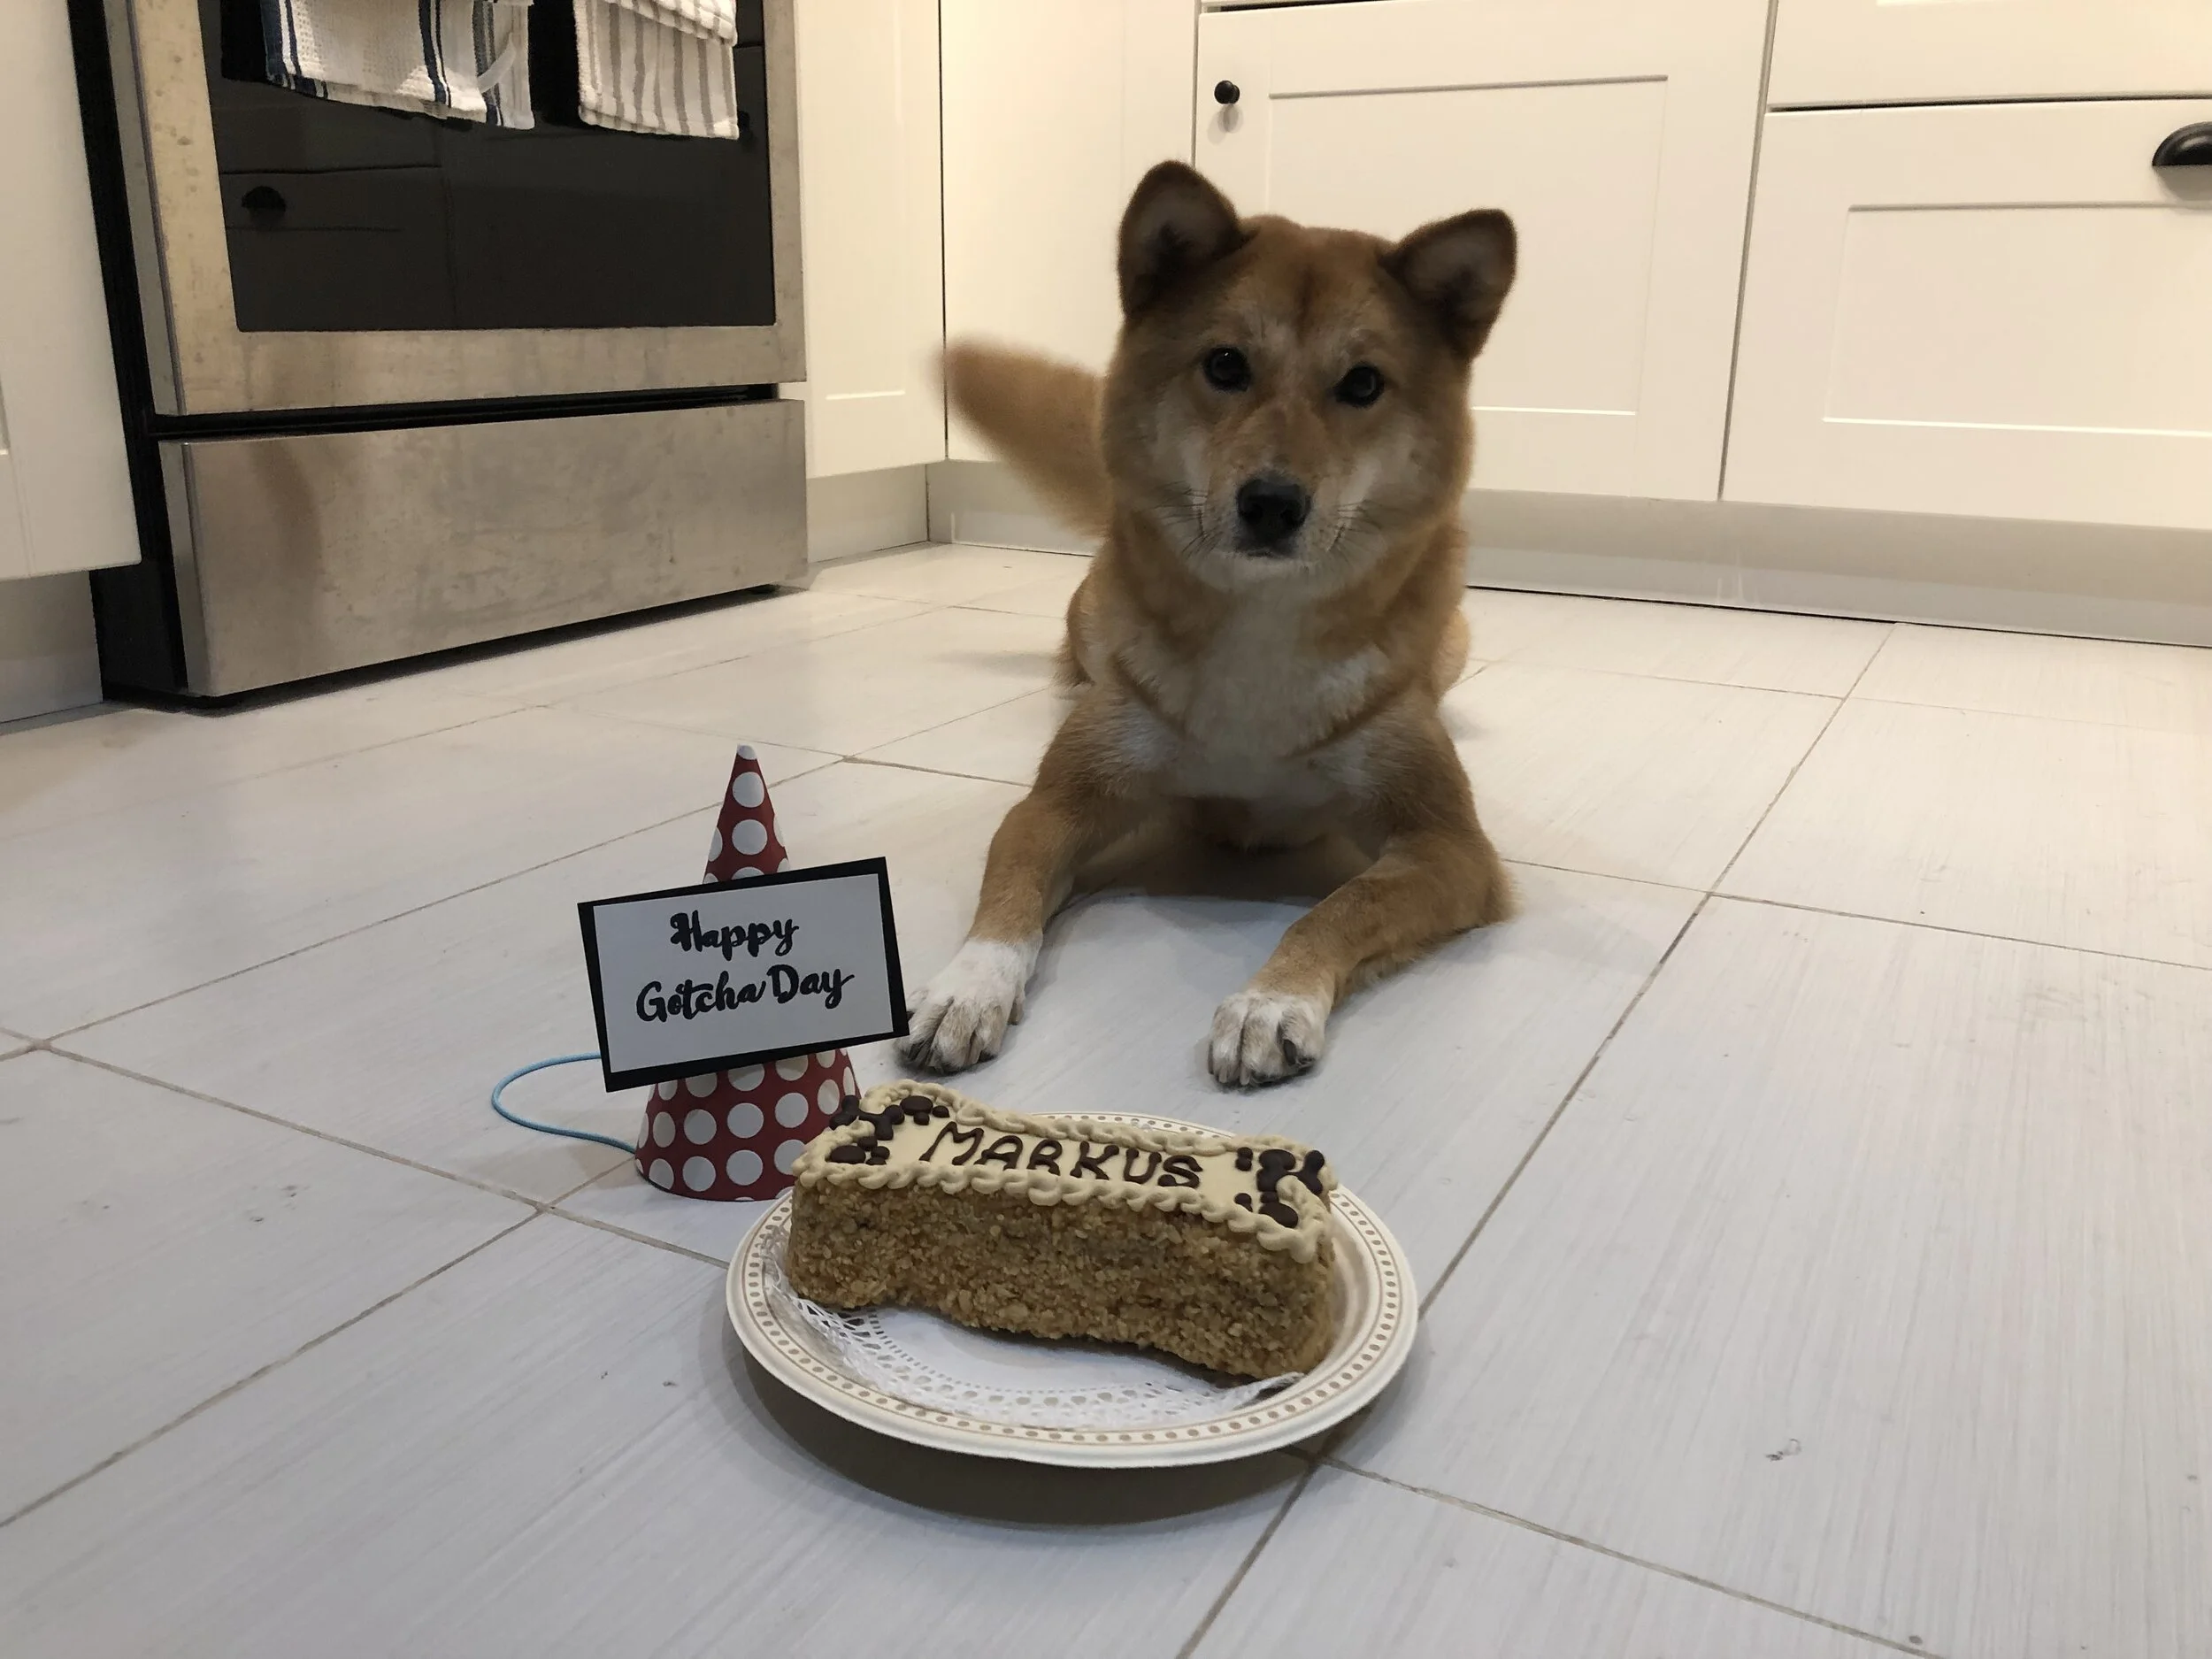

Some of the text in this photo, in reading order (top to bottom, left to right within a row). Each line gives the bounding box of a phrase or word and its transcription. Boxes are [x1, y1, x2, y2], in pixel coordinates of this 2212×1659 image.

[670, 910, 799, 961] Happy
[636, 964, 855, 1022] Gotcha Day
[918, 1120, 1203, 1188] MARKUS
